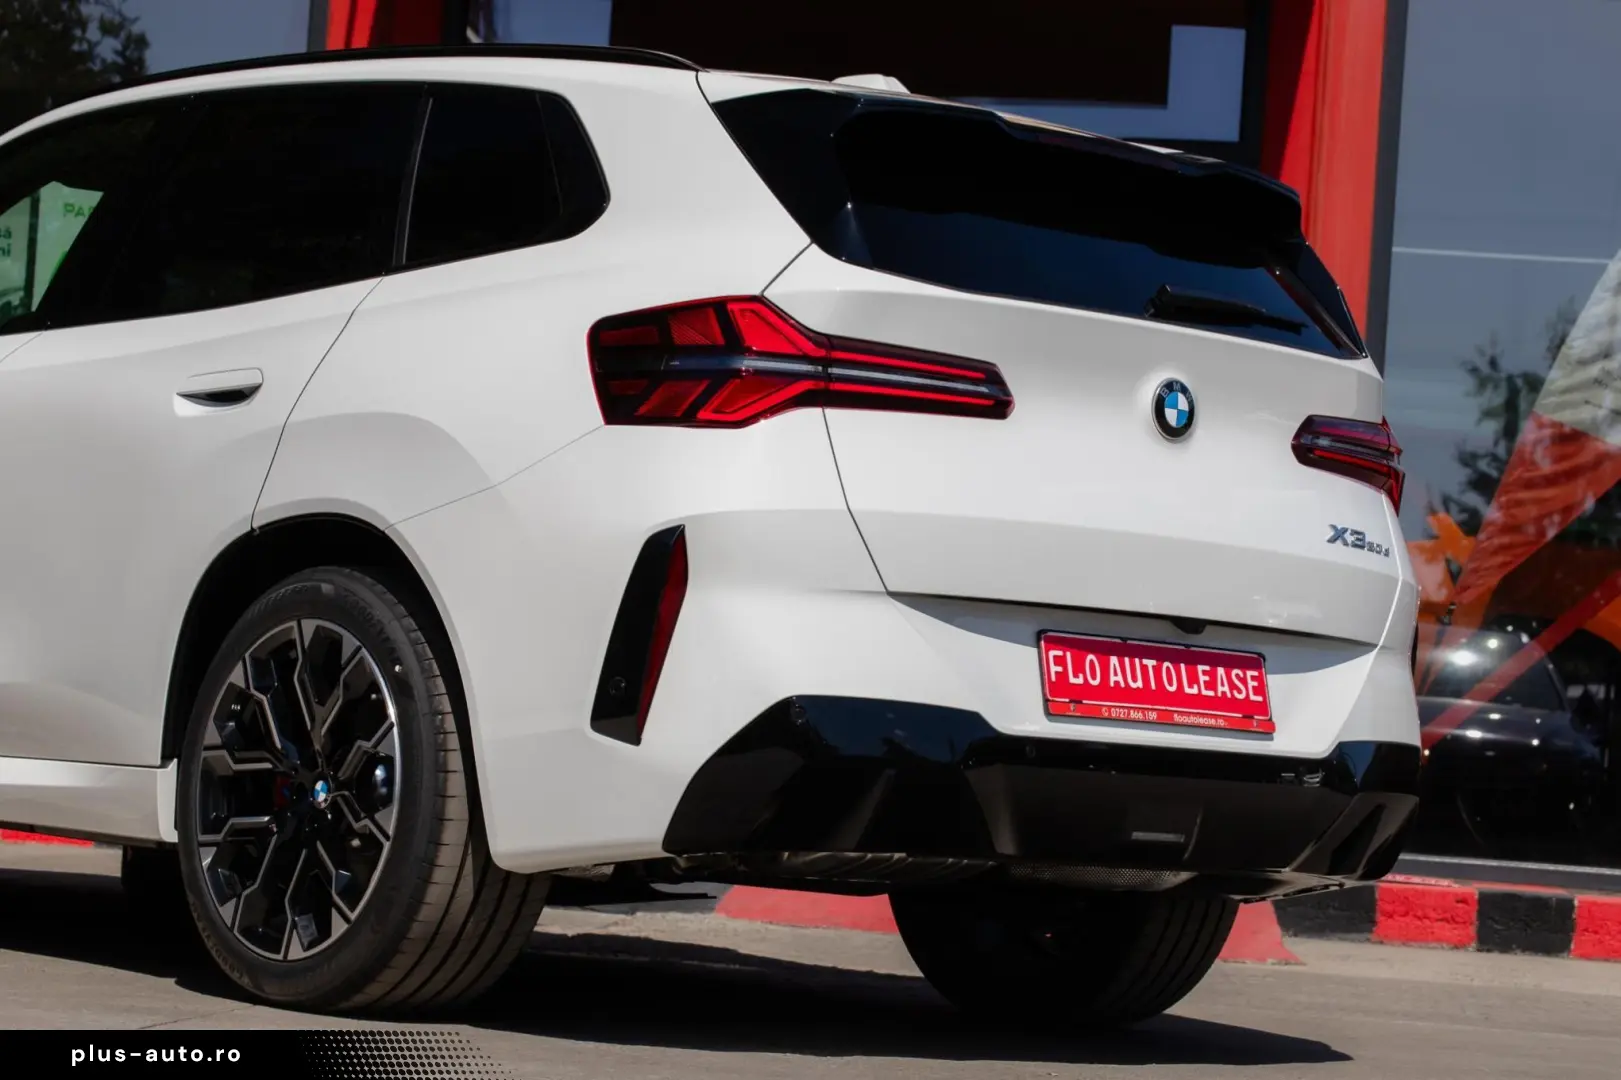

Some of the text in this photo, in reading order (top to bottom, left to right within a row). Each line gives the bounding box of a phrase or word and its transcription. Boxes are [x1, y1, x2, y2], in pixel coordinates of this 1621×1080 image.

[1048, 650, 1264, 702] FLO AUTOLEASE
[1110, 707, 1158, 721] 0727.866.159
